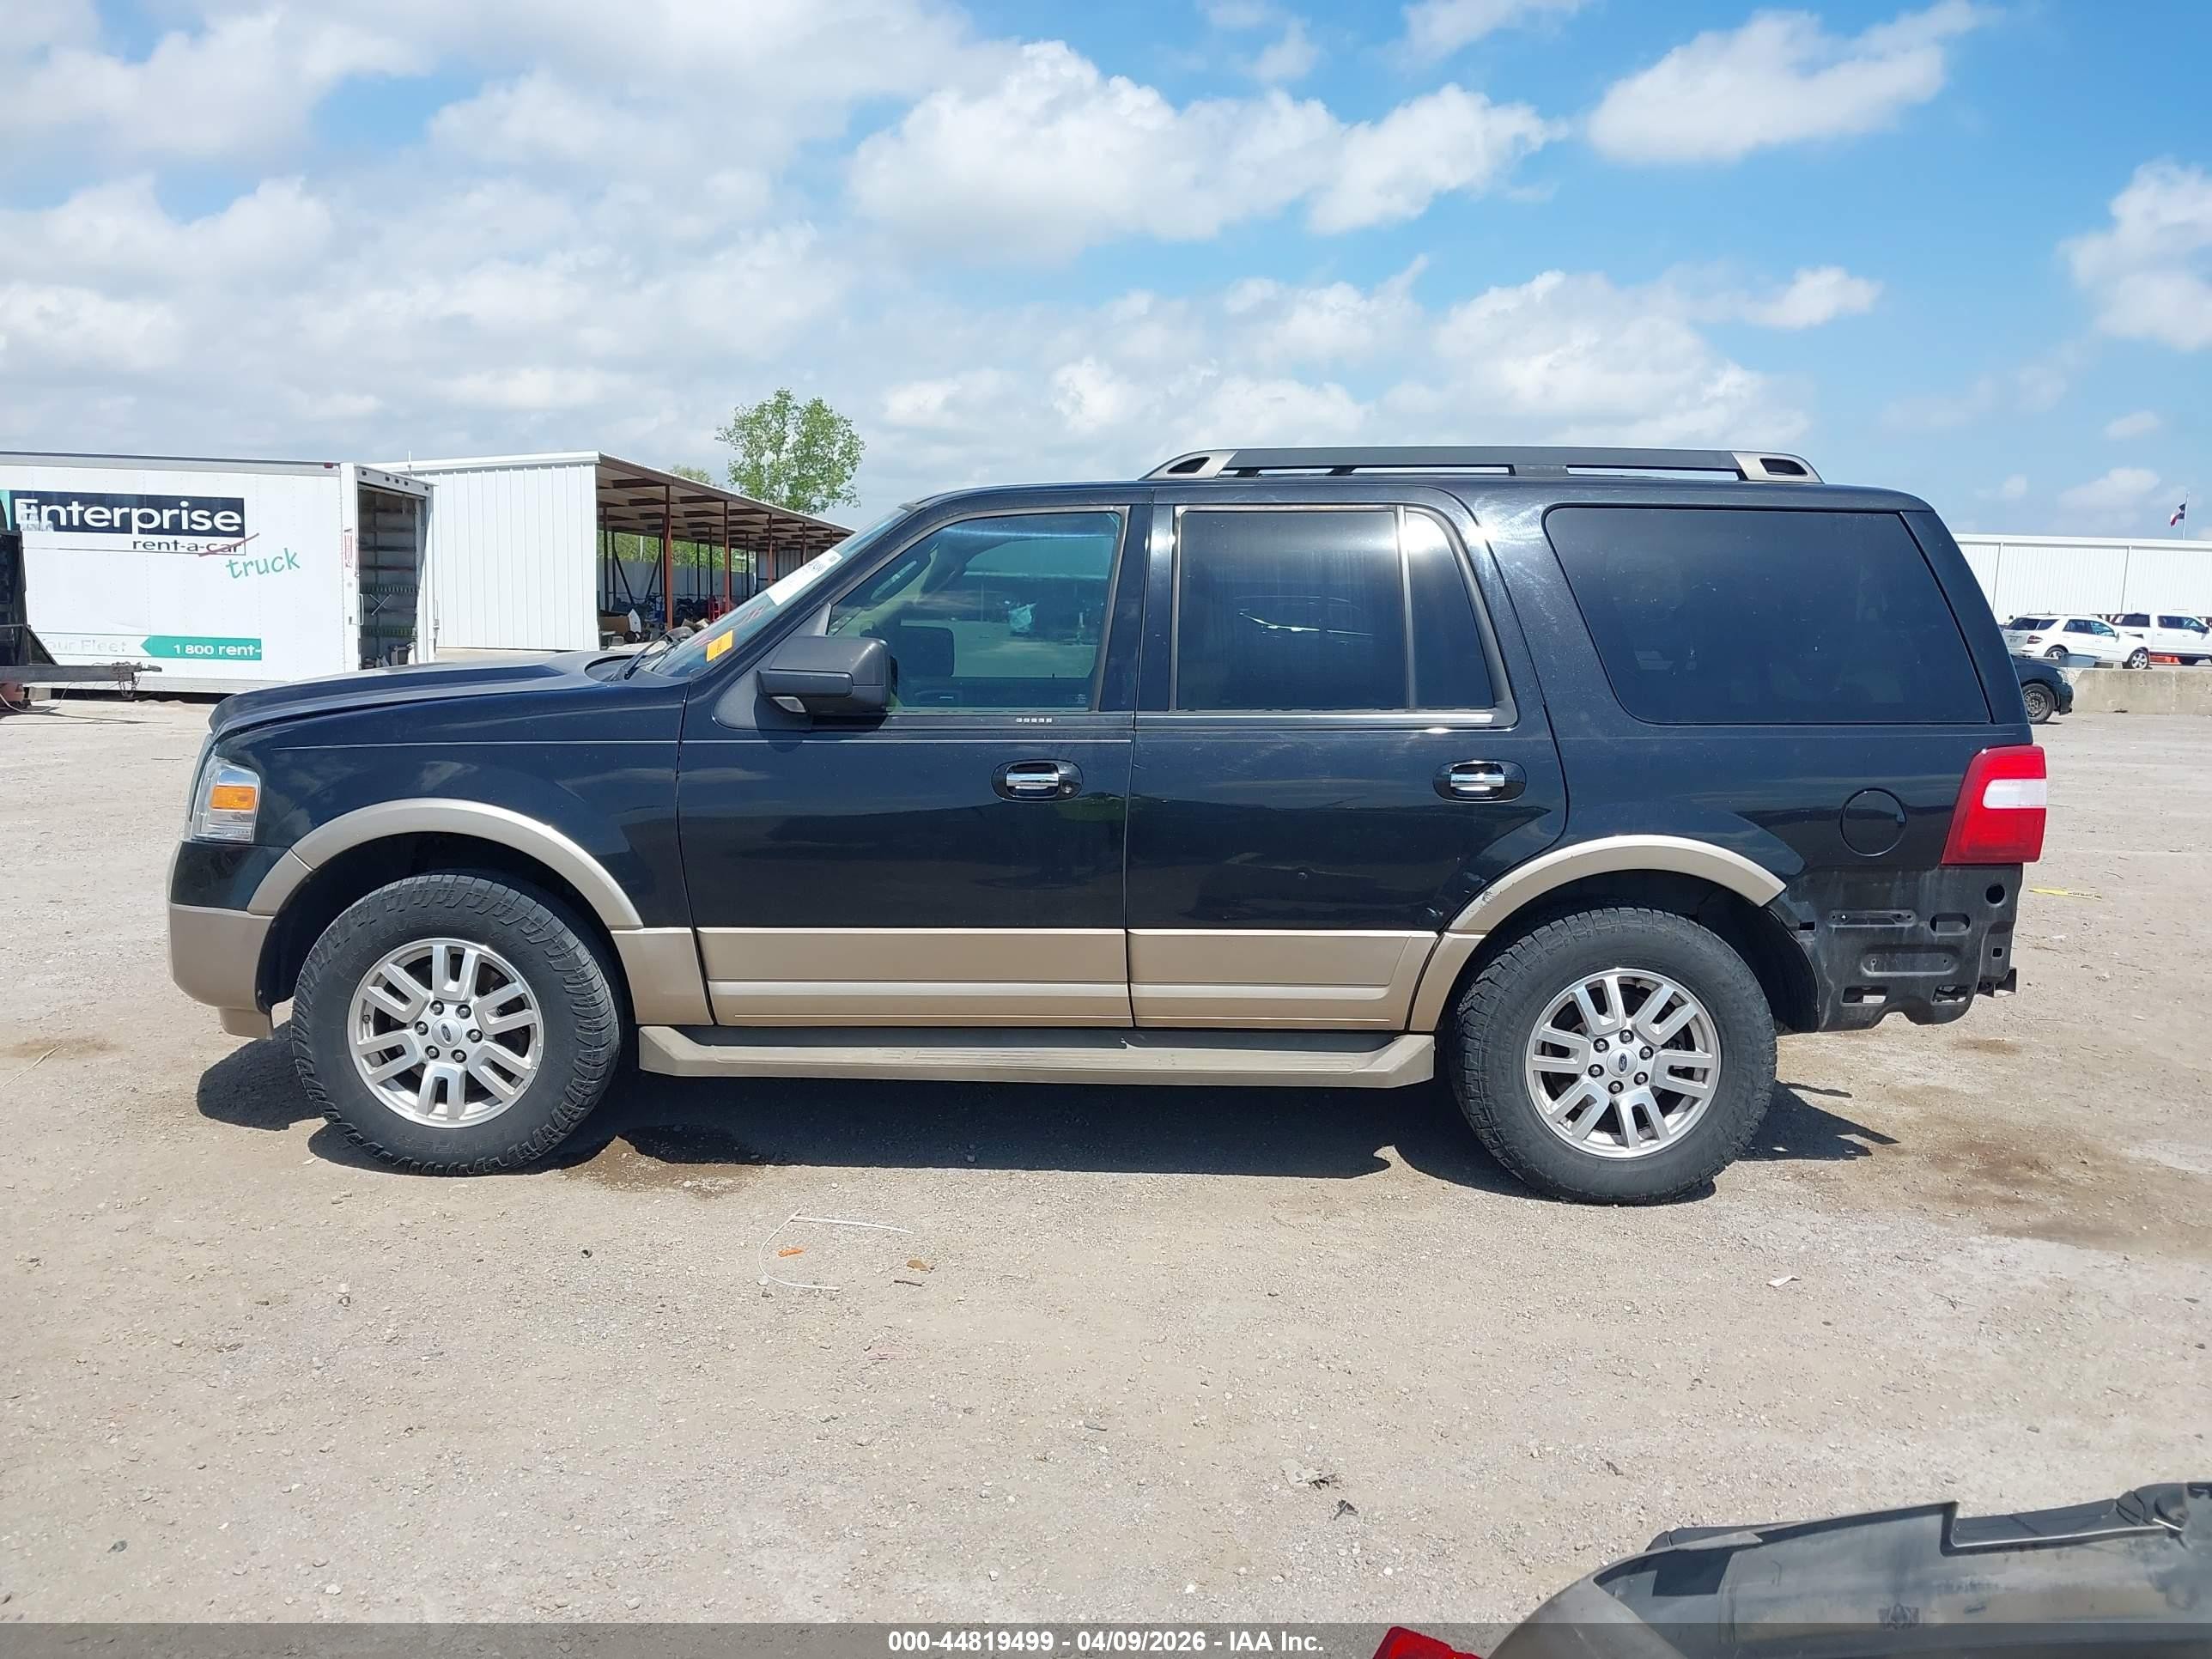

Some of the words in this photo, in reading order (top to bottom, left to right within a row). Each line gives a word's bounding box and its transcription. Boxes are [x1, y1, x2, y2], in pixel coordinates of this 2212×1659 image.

[15, 498, 242, 534] Enterprise
[133, 538, 241, 553] rent-a-car
[225, 547, 301, 579] truck
[41, 637, 76, 651] our
[173, 644, 180, 654] 1
[185, 644, 215, 655] 800
[218, 644, 261, 656] rent-
